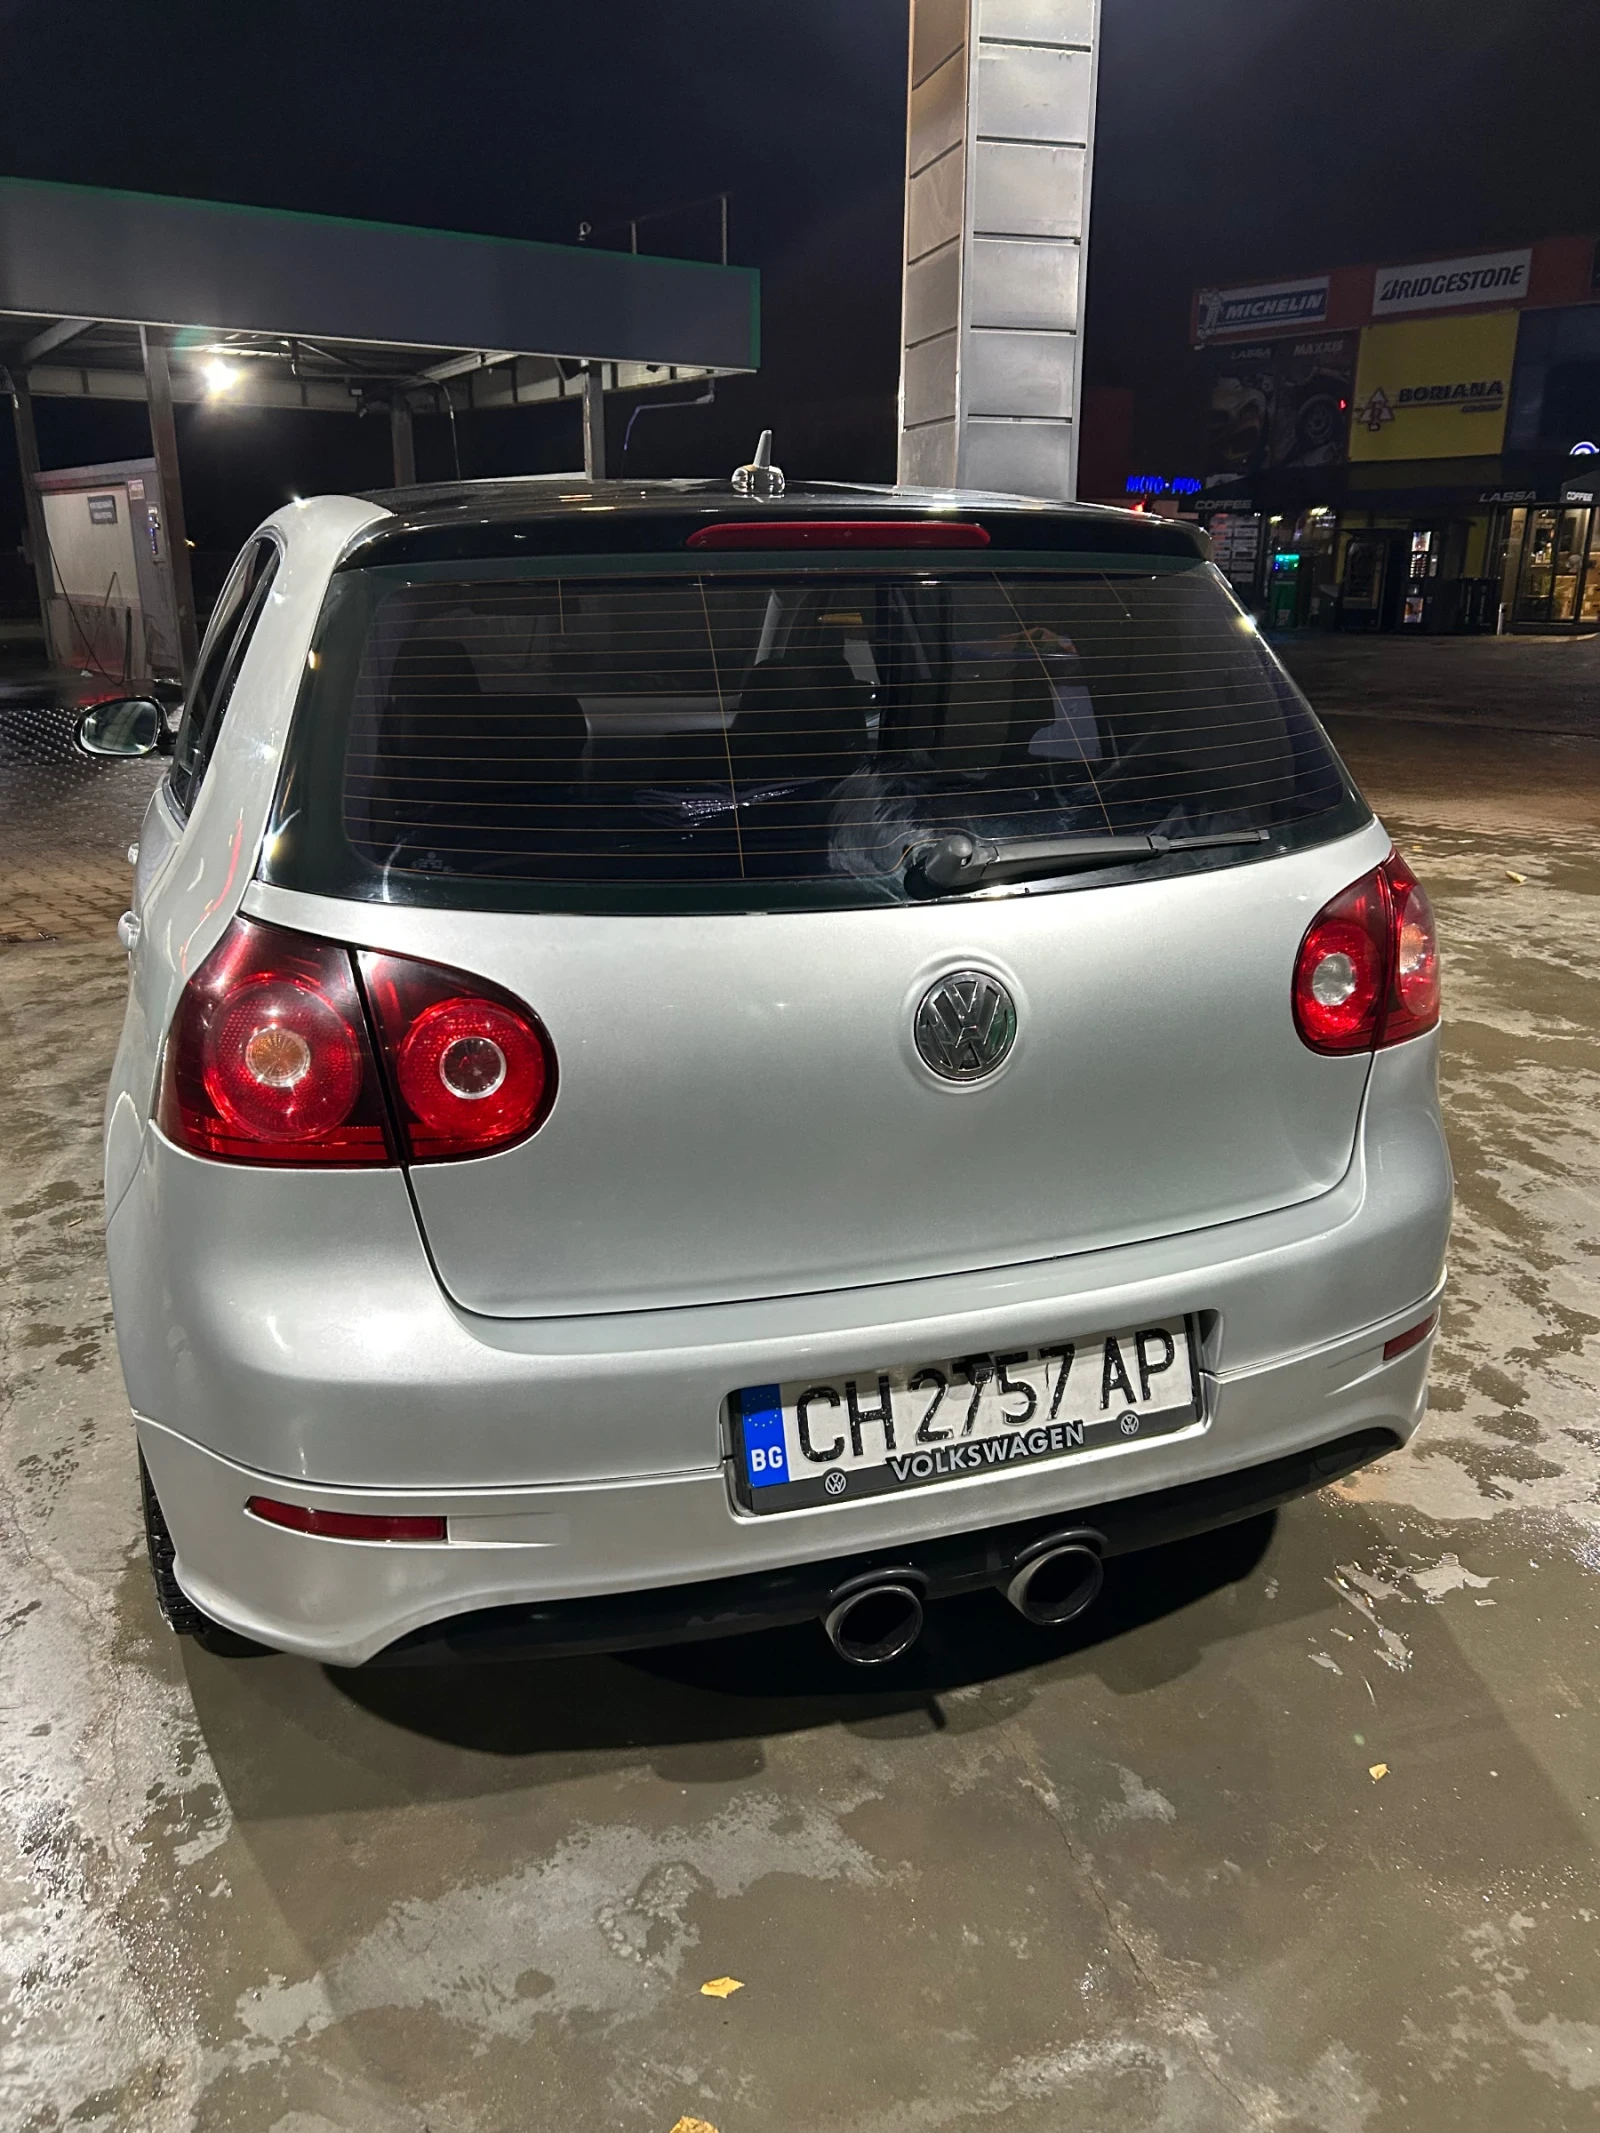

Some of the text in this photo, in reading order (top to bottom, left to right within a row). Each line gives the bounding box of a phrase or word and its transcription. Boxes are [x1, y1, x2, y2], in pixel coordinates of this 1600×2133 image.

[1379, 264, 1526, 301] BRIDGESTONE
[1224, 294, 1324, 320] MICHELIN
[1399, 380, 1503, 402] BORIANA
[1195, 500, 1252, 510] COFFEE
[1478, 491, 1537, 502] LASSA
[1566, 491, 1594, 502] COFFEE
[1100, 1328, 1176, 1411] AP
[750, 1447, 785, 1473] BG
[890, 1422, 1086, 1482] VOLKSWAGEN
